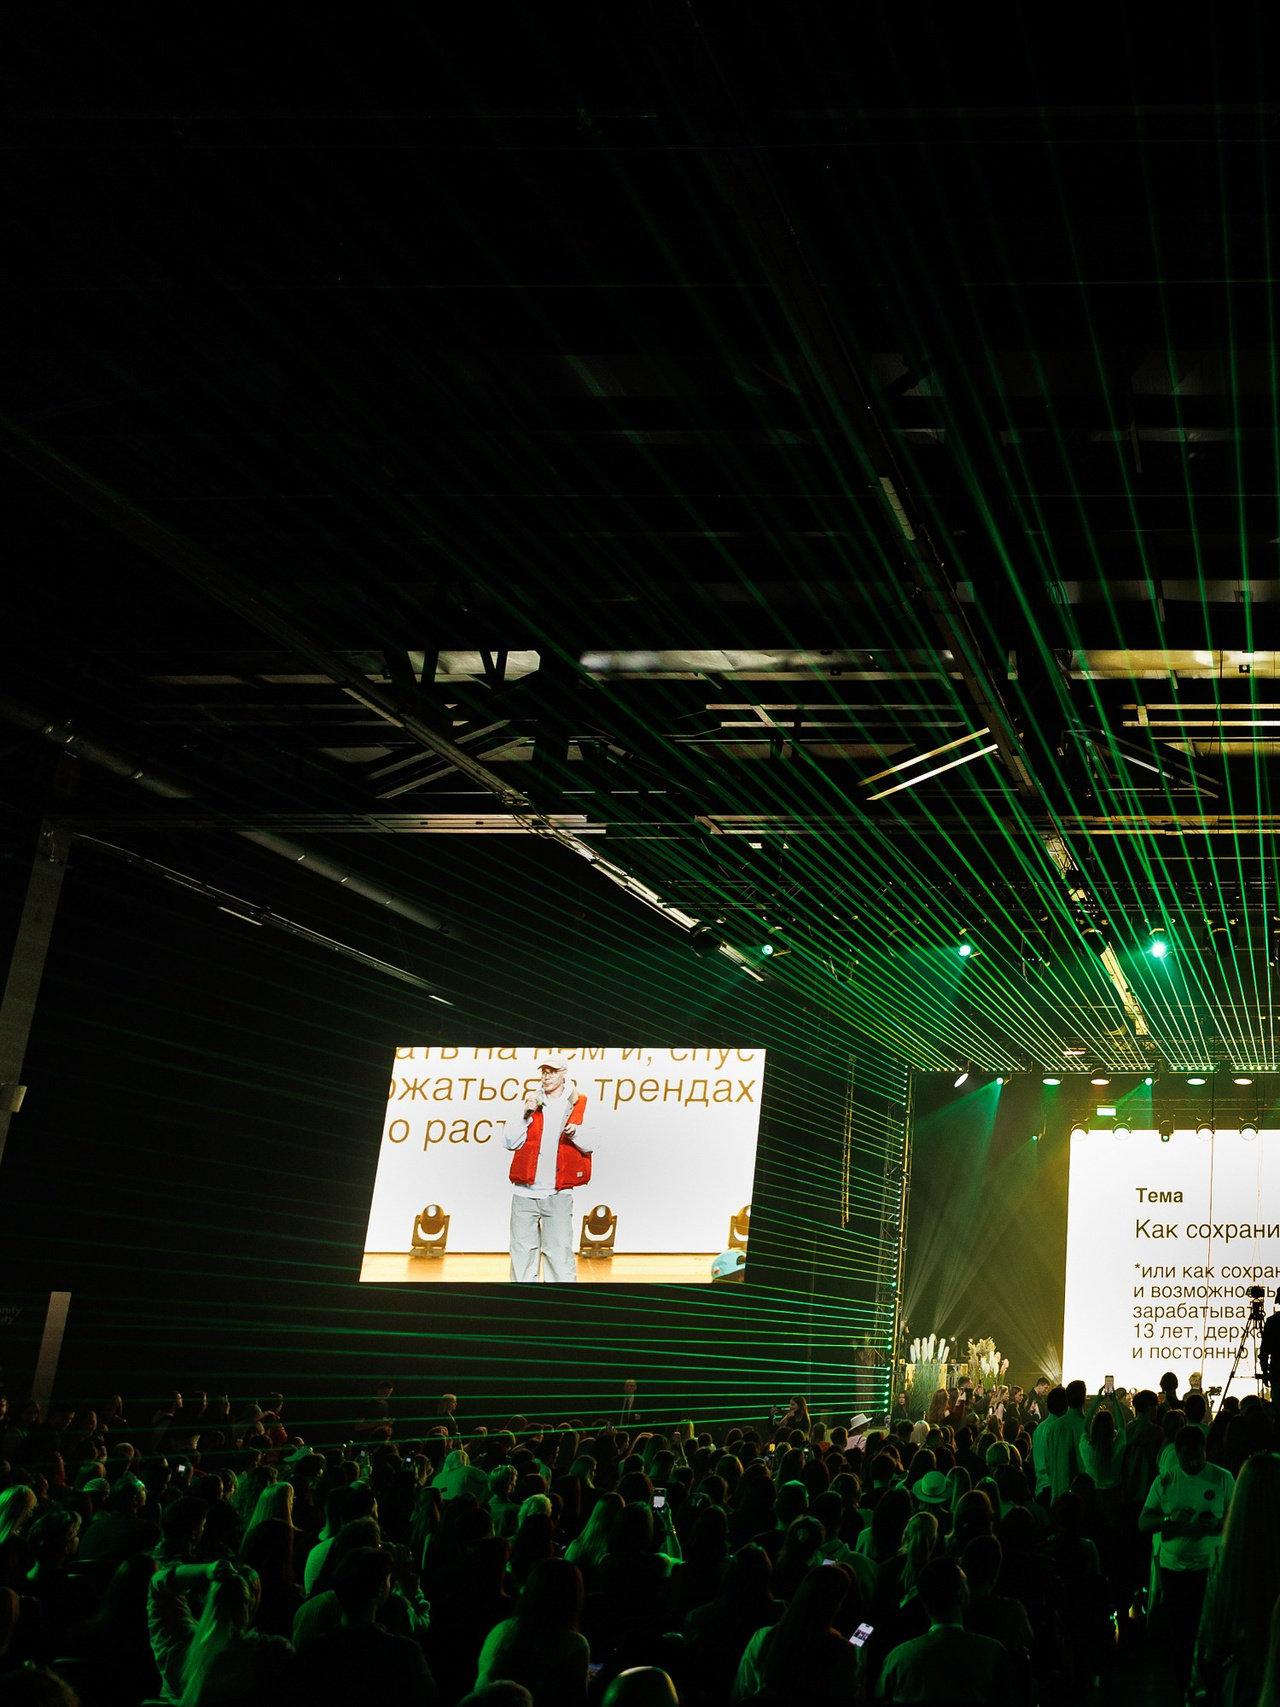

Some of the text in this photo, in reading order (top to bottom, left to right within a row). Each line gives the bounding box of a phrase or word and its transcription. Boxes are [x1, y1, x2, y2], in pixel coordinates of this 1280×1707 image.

[594, 1078, 756, 1110] трендах
[388, 1119, 410, 1144] о
[1136, 1187, 1184, 1203] Тема
[1135, 1219, 1178, 1239] Как
[1182, 1266, 1215, 1279] как
[1133, 1286, 1144, 1298] и
[1134, 1324, 1154, 1338] 13
[1160, 1326, 1199, 1341] лет,
[1132, 1347, 1143, 1359] и
[1150, 1347, 1249, 1359] постоянно
